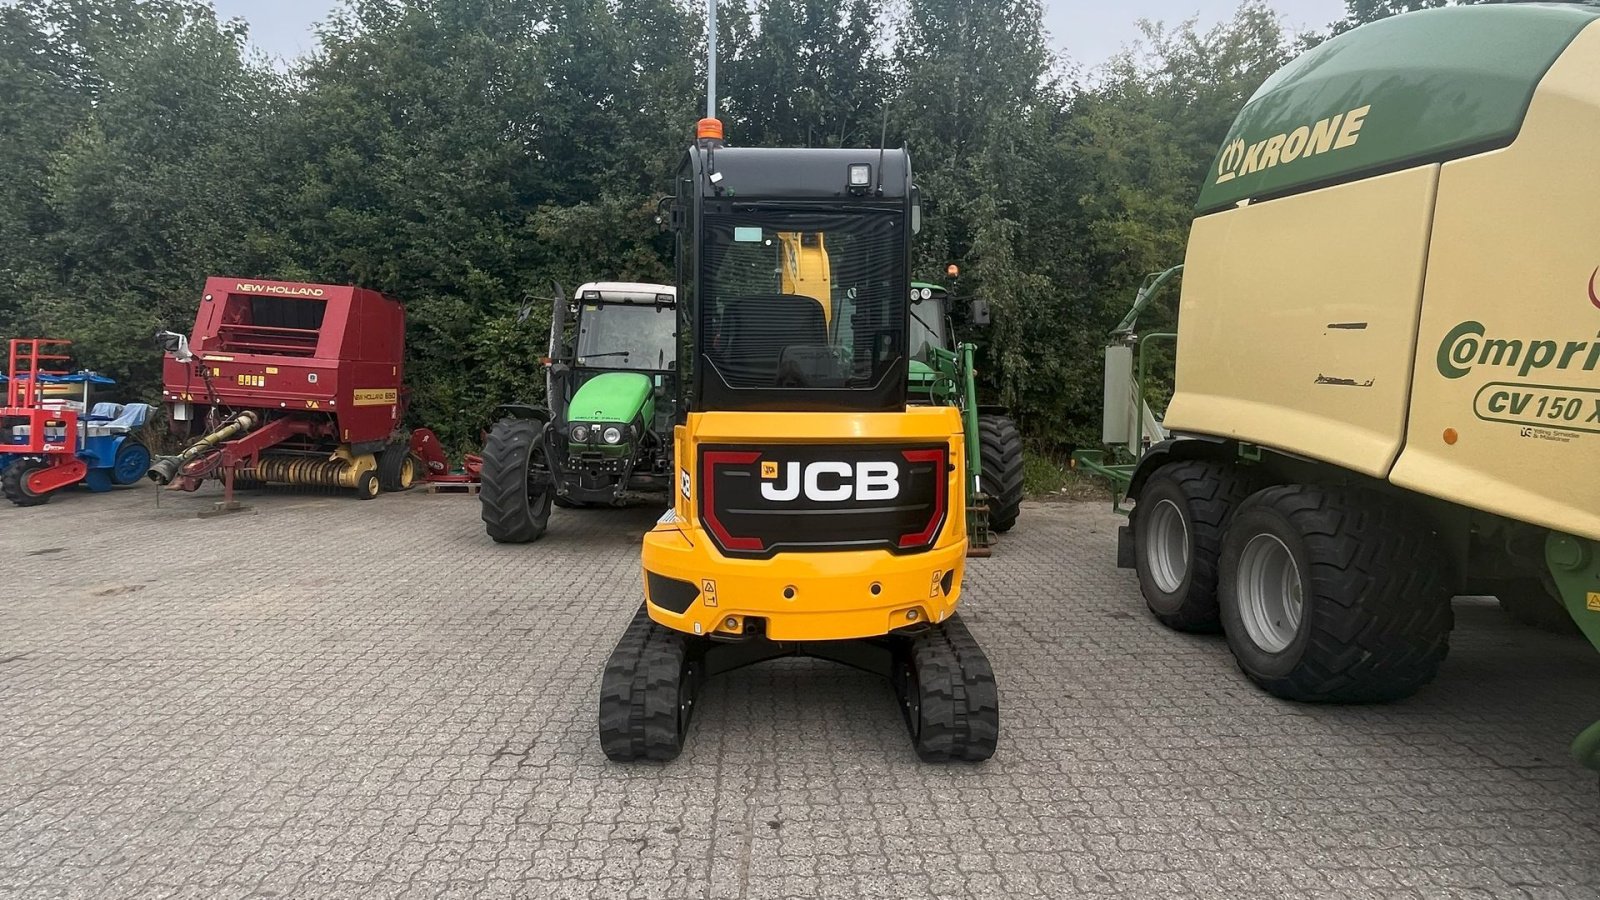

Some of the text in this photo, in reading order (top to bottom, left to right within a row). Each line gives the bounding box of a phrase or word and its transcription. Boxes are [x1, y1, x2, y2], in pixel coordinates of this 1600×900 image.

[1238, 104, 1371, 177] KRONE
[236, 283, 323, 296] NEW HOLLAND
[1488, 391, 1534, 415] CV
[1536, 395, 1583, 421] 150
[681, 469, 691, 498] CB
[760, 461, 899, 501] JCB
